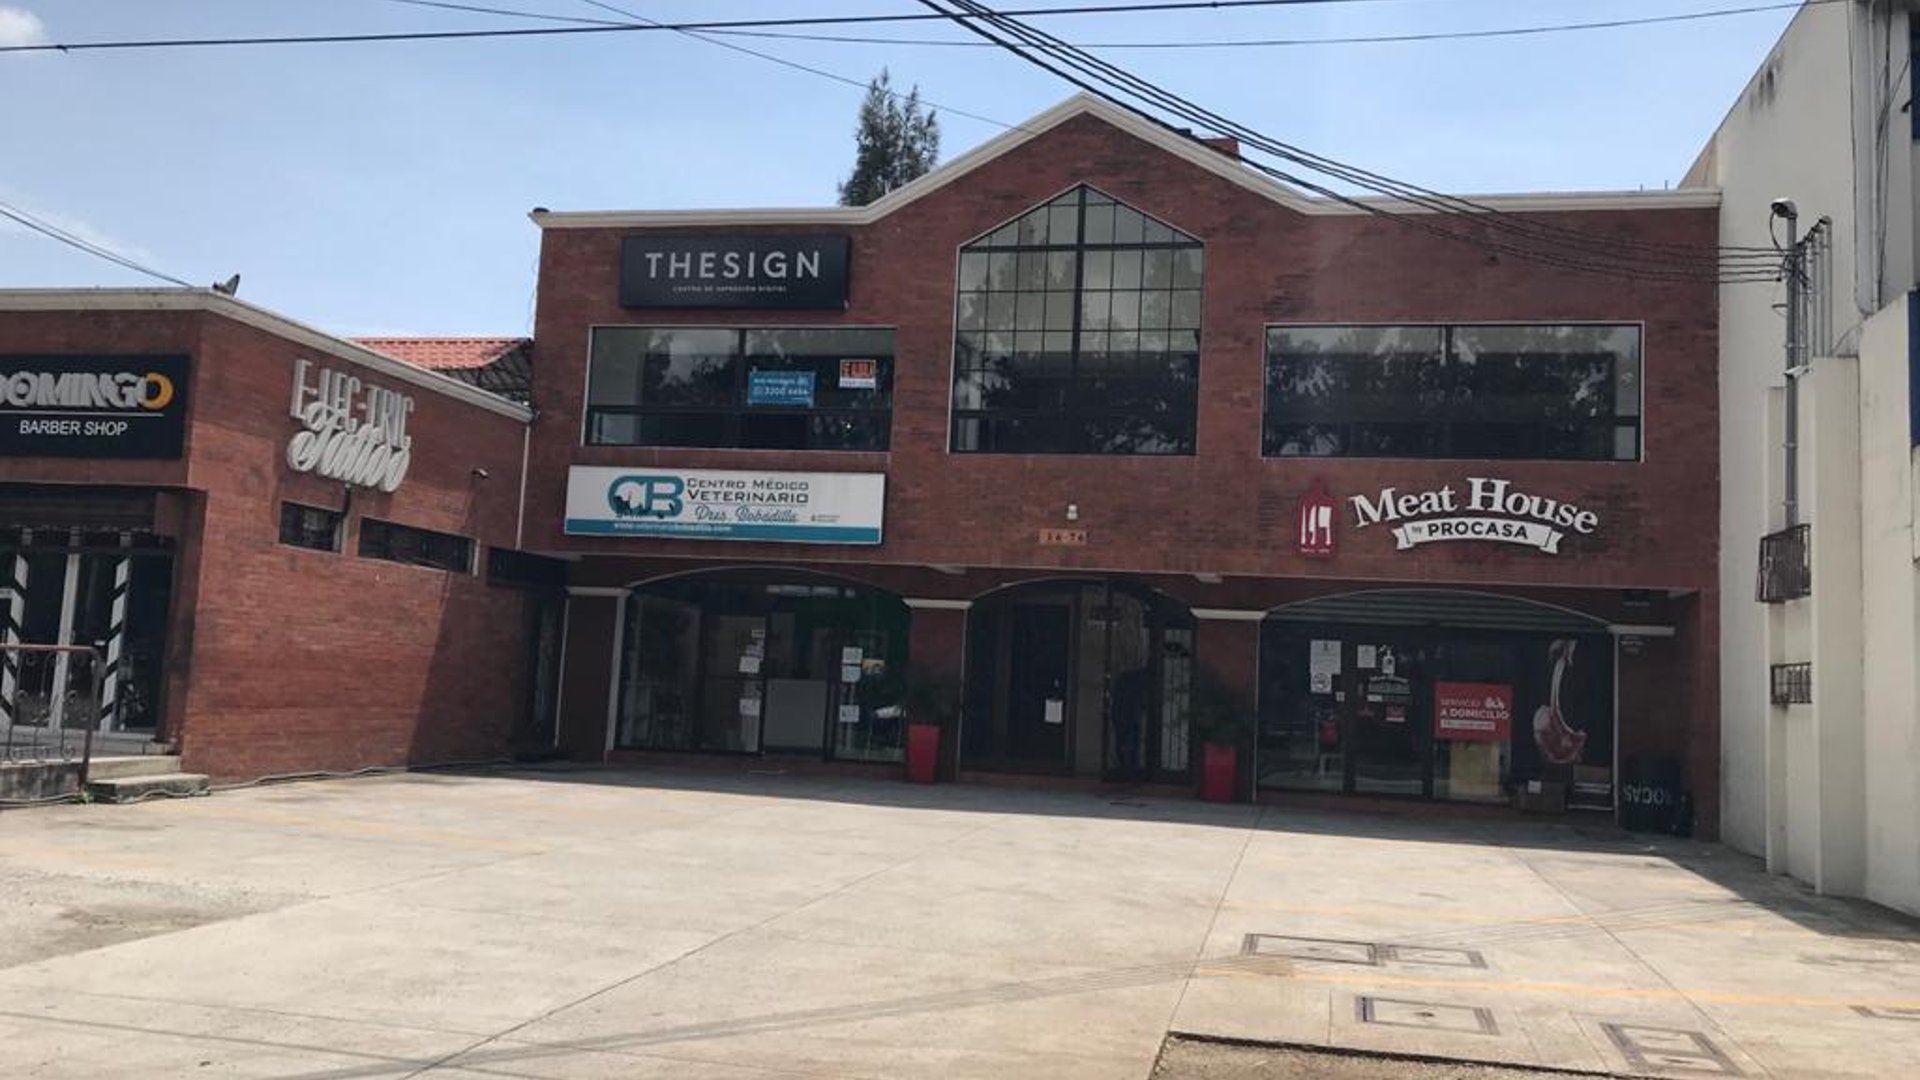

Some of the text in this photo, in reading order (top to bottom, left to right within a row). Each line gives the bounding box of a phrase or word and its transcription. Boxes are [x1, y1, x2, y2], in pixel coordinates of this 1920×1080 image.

[645, 251, 820, 278] THESIGN
[19, 419, 129, 437] BARBER SHOP
[686, 489, 809, 504] VETERINARIO
[1349, 477, 1599, 534] Meat House
[1427, 521, 1529, 538] PROCASA
[1440, 708, 1511, 720] A DOMICILIO
